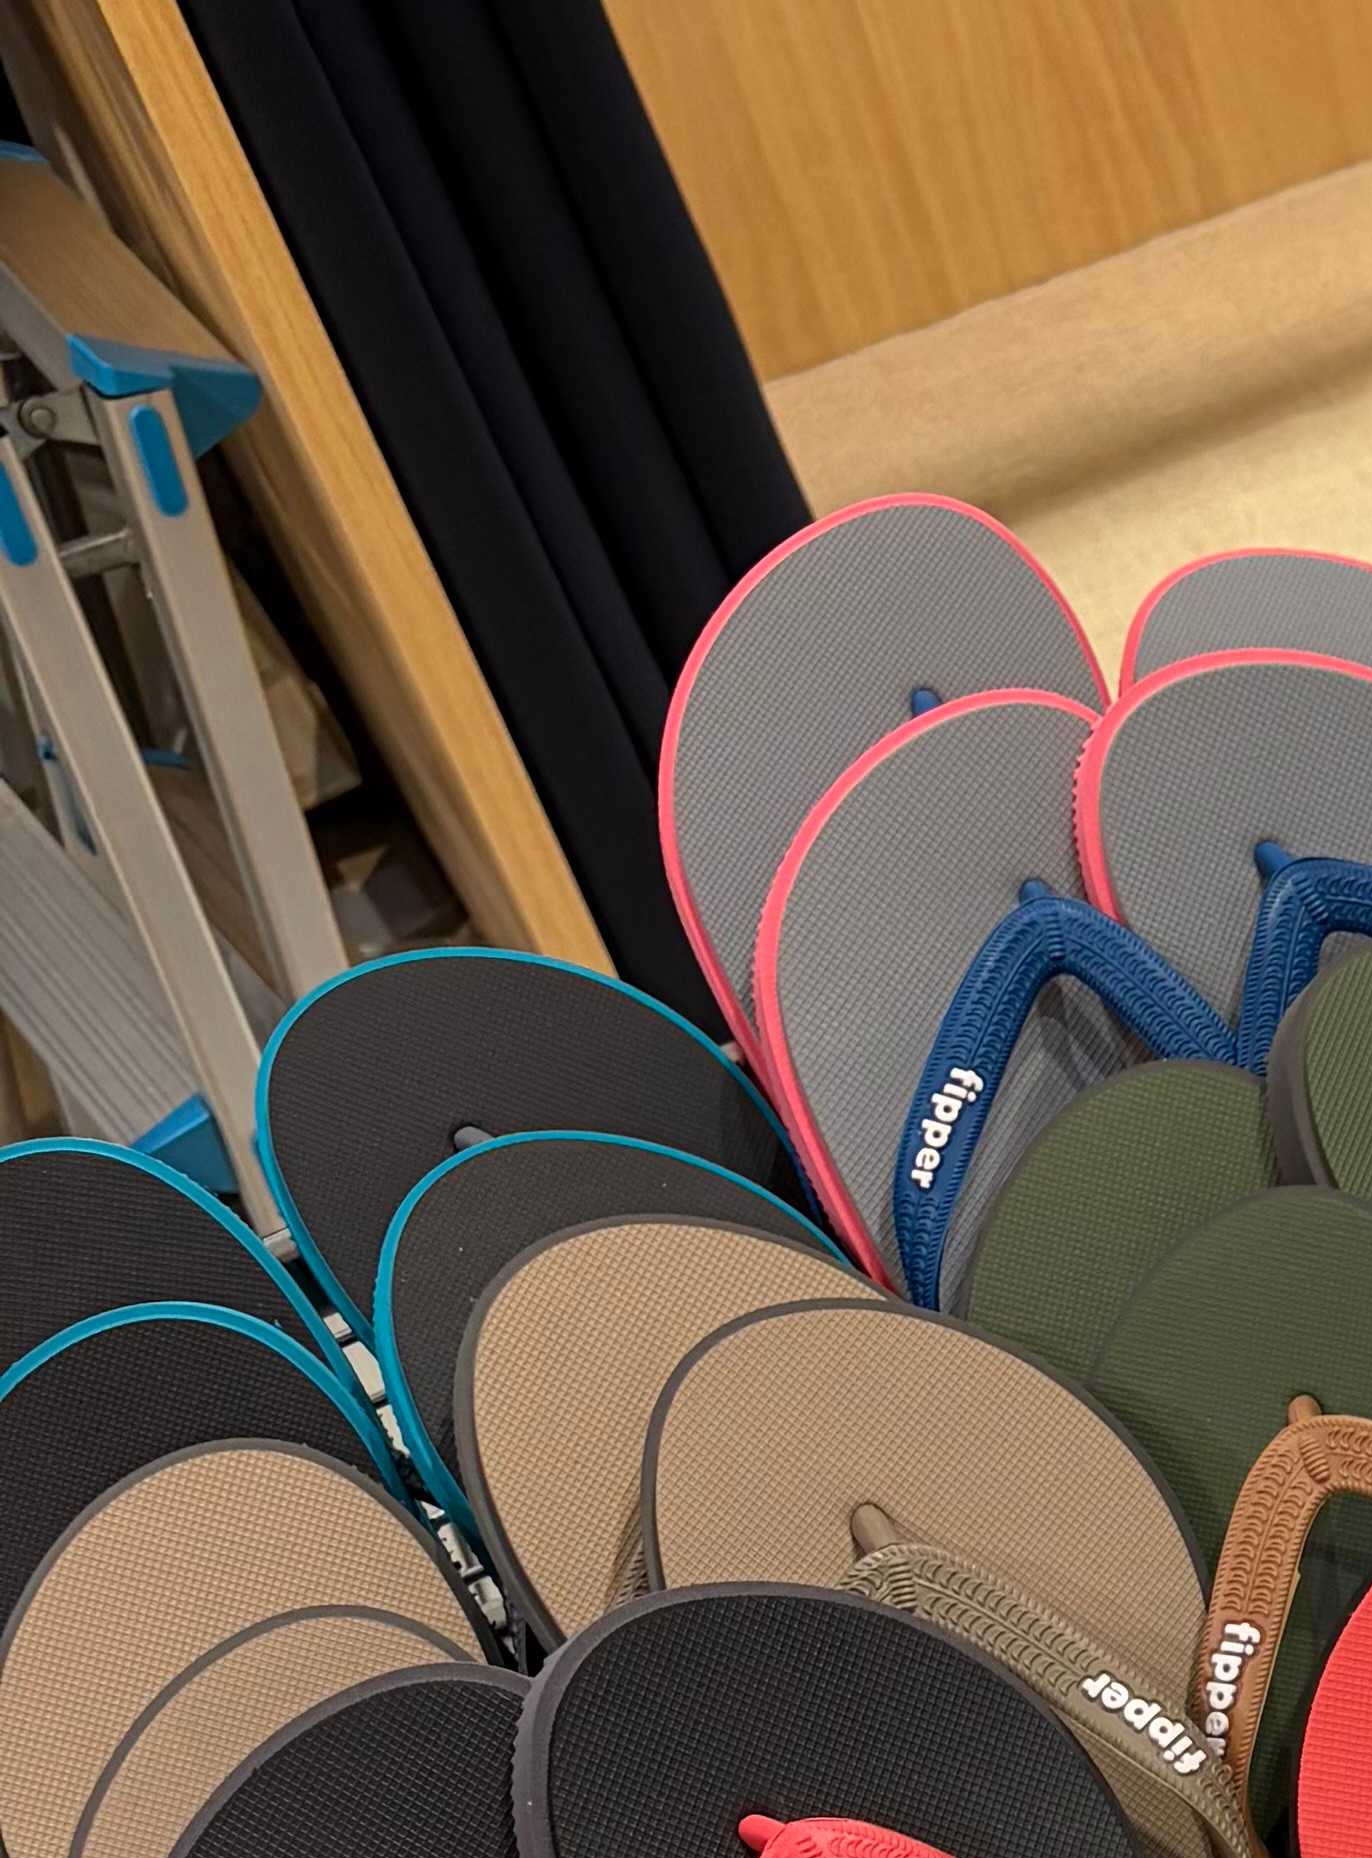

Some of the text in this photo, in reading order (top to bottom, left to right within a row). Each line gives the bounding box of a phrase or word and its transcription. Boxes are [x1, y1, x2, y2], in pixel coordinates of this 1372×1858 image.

[911, 1067, 984, 1189] fipper
[1081, 1673, 1207, 1774] fipper
[1204, 1622, 1260, 1755] fipper
